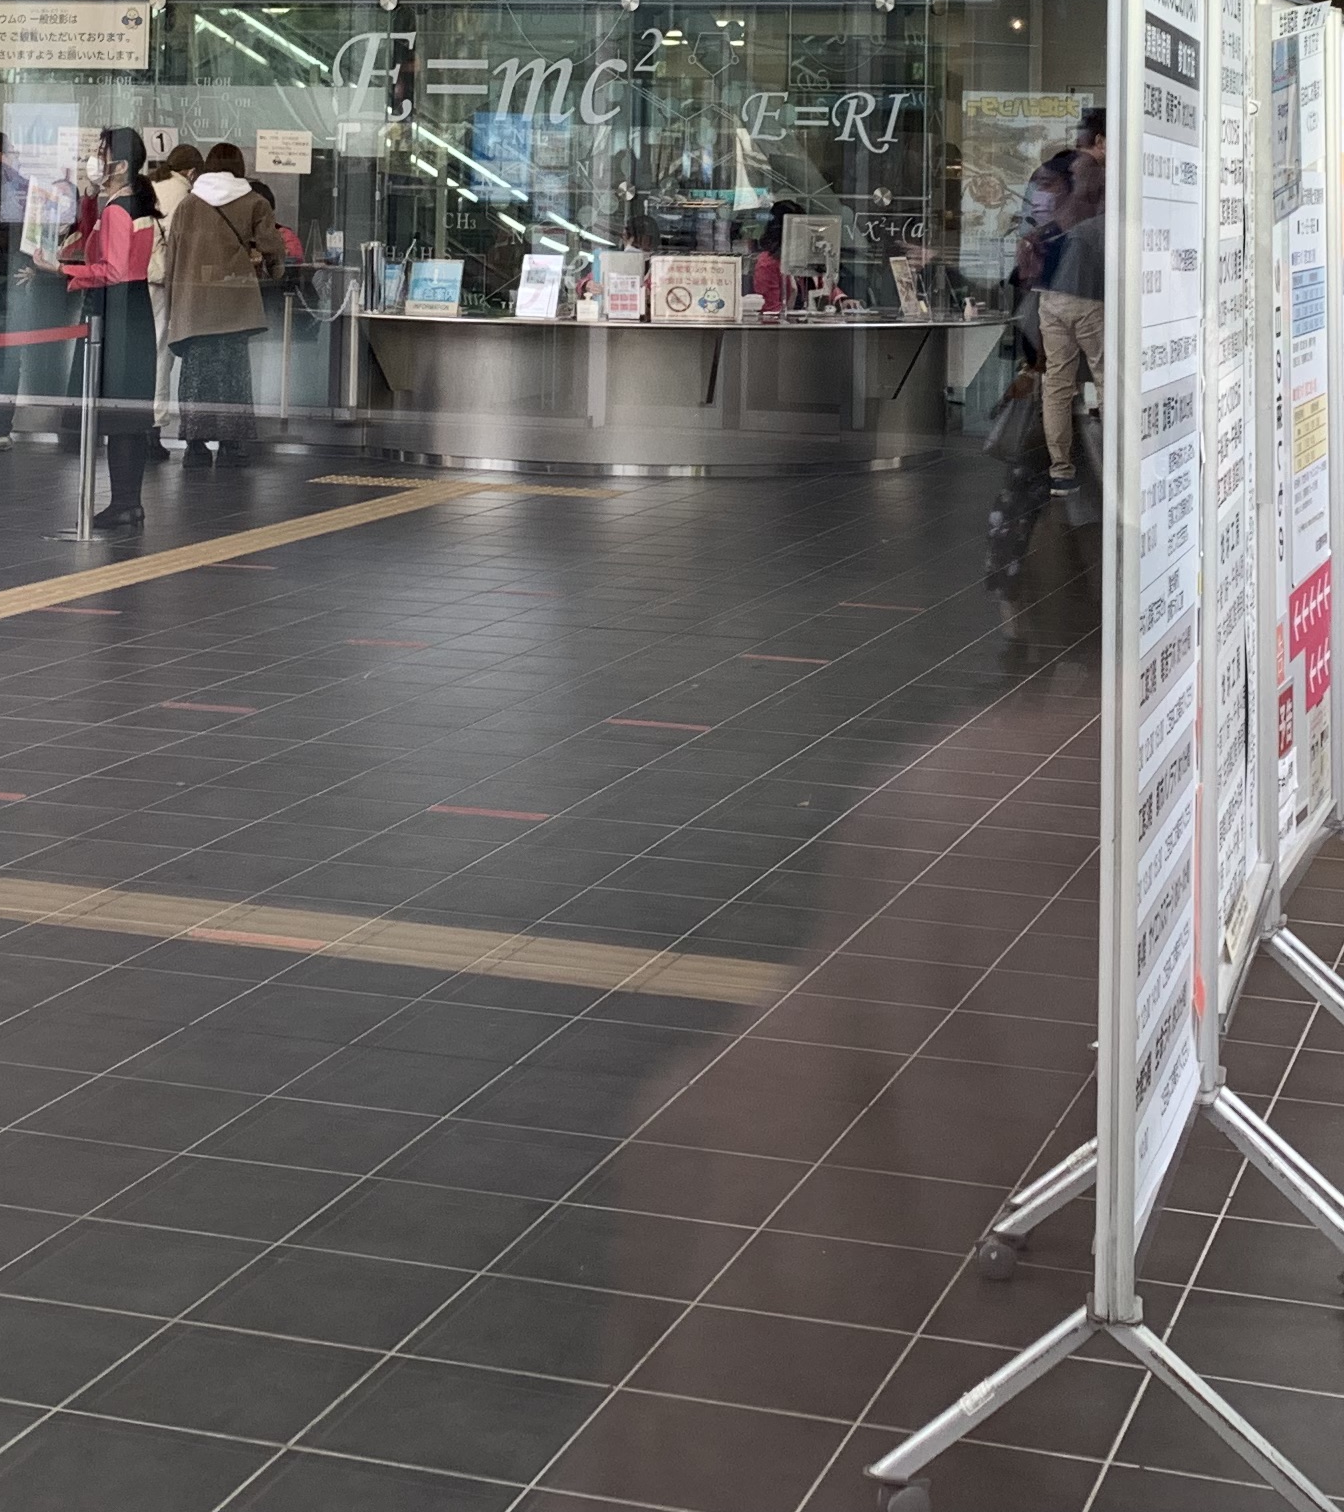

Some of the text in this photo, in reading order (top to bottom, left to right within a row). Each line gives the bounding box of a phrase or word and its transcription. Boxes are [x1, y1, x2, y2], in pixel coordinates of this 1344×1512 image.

[30, 13, 77, 25] 一般投影は
[58, 49, 140, 61] お願いいたします。
[742, 91, 913, 154] E=RI
[156, 132, 165, 152] 1
